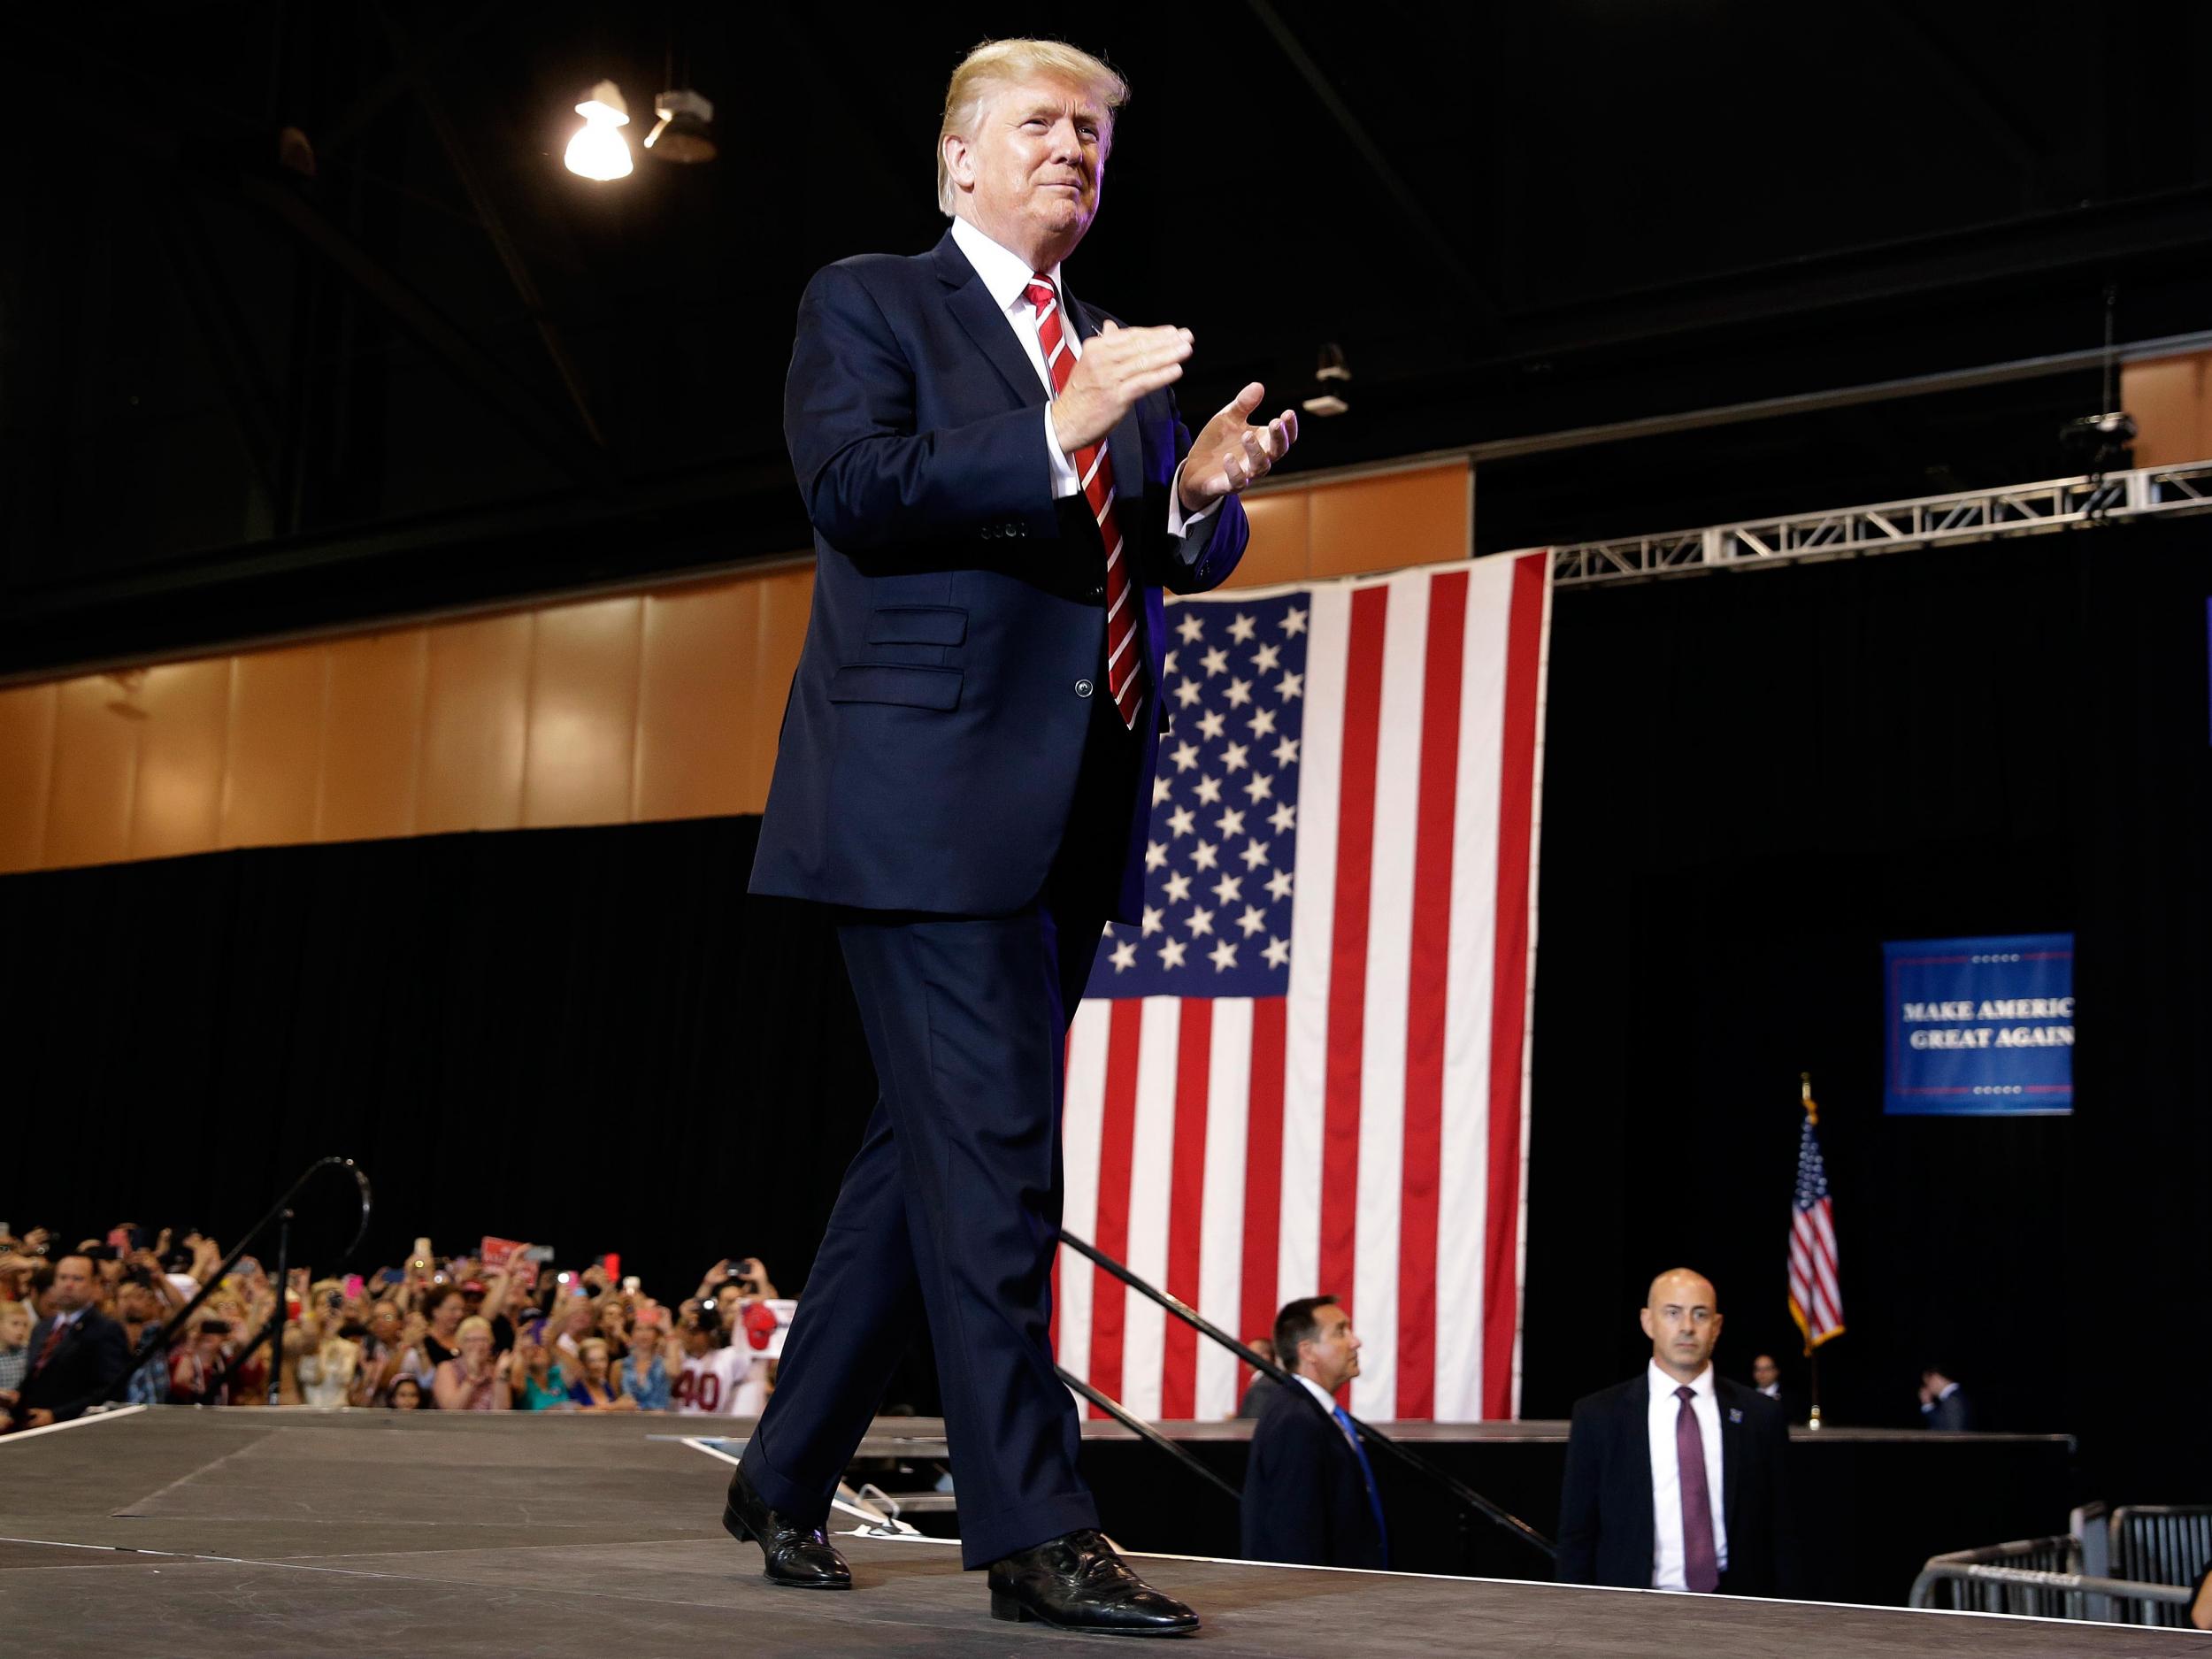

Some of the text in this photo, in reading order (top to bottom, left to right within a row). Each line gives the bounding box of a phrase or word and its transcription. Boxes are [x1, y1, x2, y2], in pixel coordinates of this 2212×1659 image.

[1903, 997, 2075, 1022] MAKE AMERIC
[1909, 1025, 2075, 1049] GREAT AGAIN
[671, 1370, 719, 1411] 40
